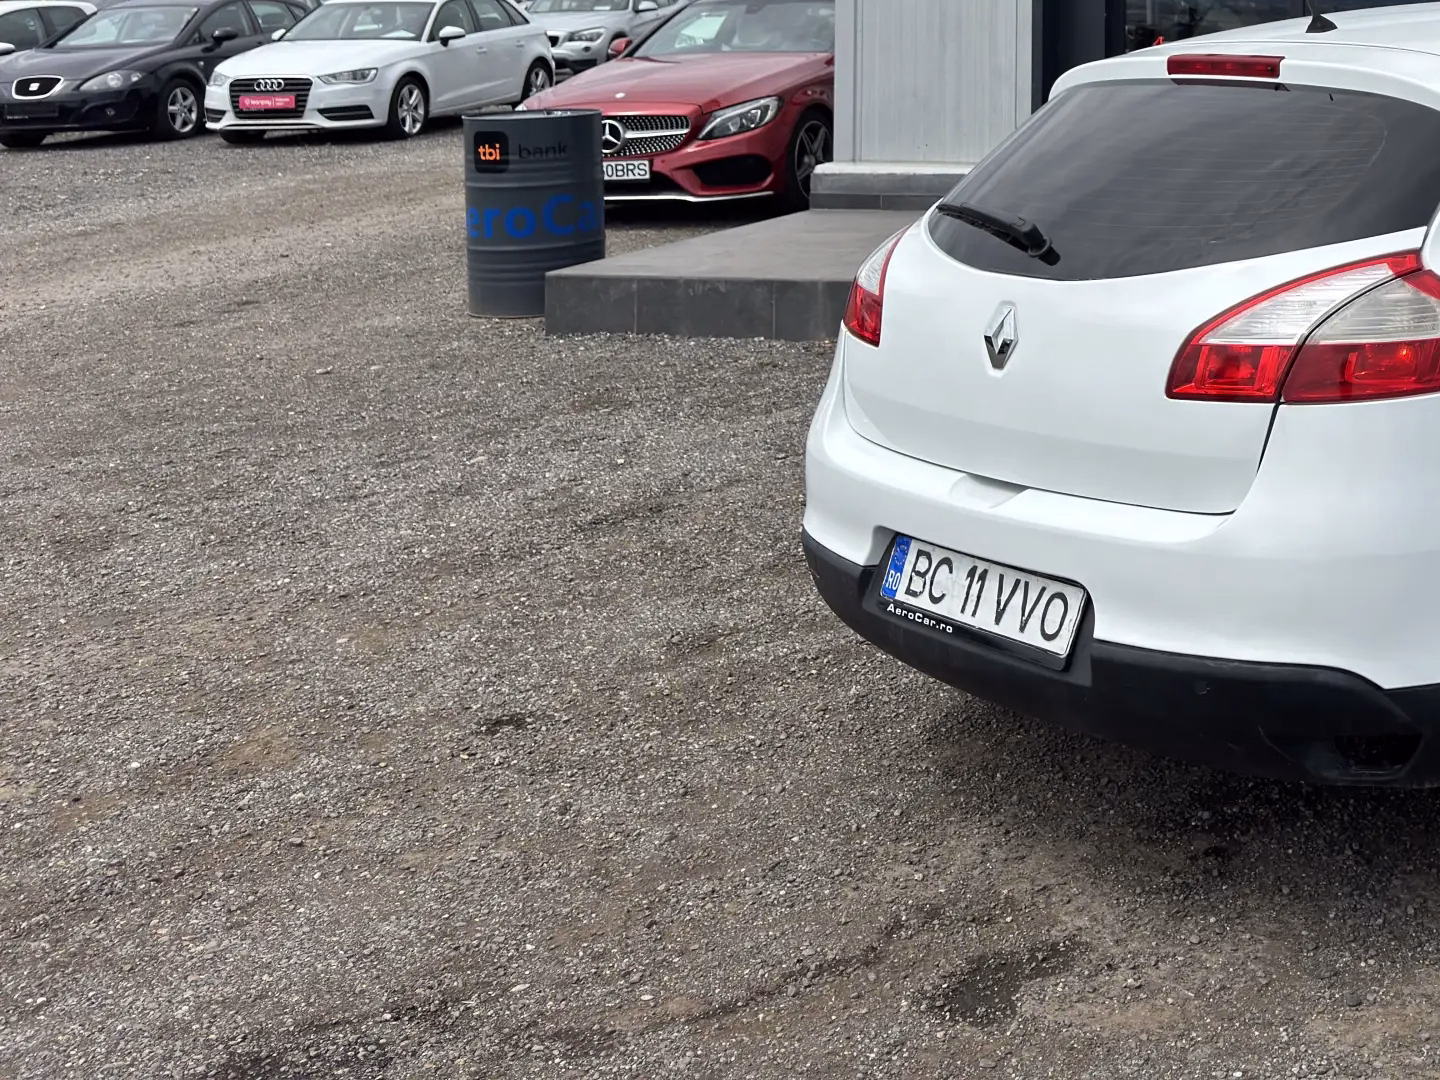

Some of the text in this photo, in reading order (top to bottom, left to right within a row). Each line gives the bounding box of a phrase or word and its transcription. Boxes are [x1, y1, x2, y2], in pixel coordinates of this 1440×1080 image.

[478, 140, 568, 161] tbi bank
[602, 162, 648, 179] 0BRS
[466, 193, 601, 239] eroCa
[885, 571, 900, 590] RO
[904, 548, 1069, 641] BC 11 VVO
[886, 603, 953, 634] AeroCar.ro
